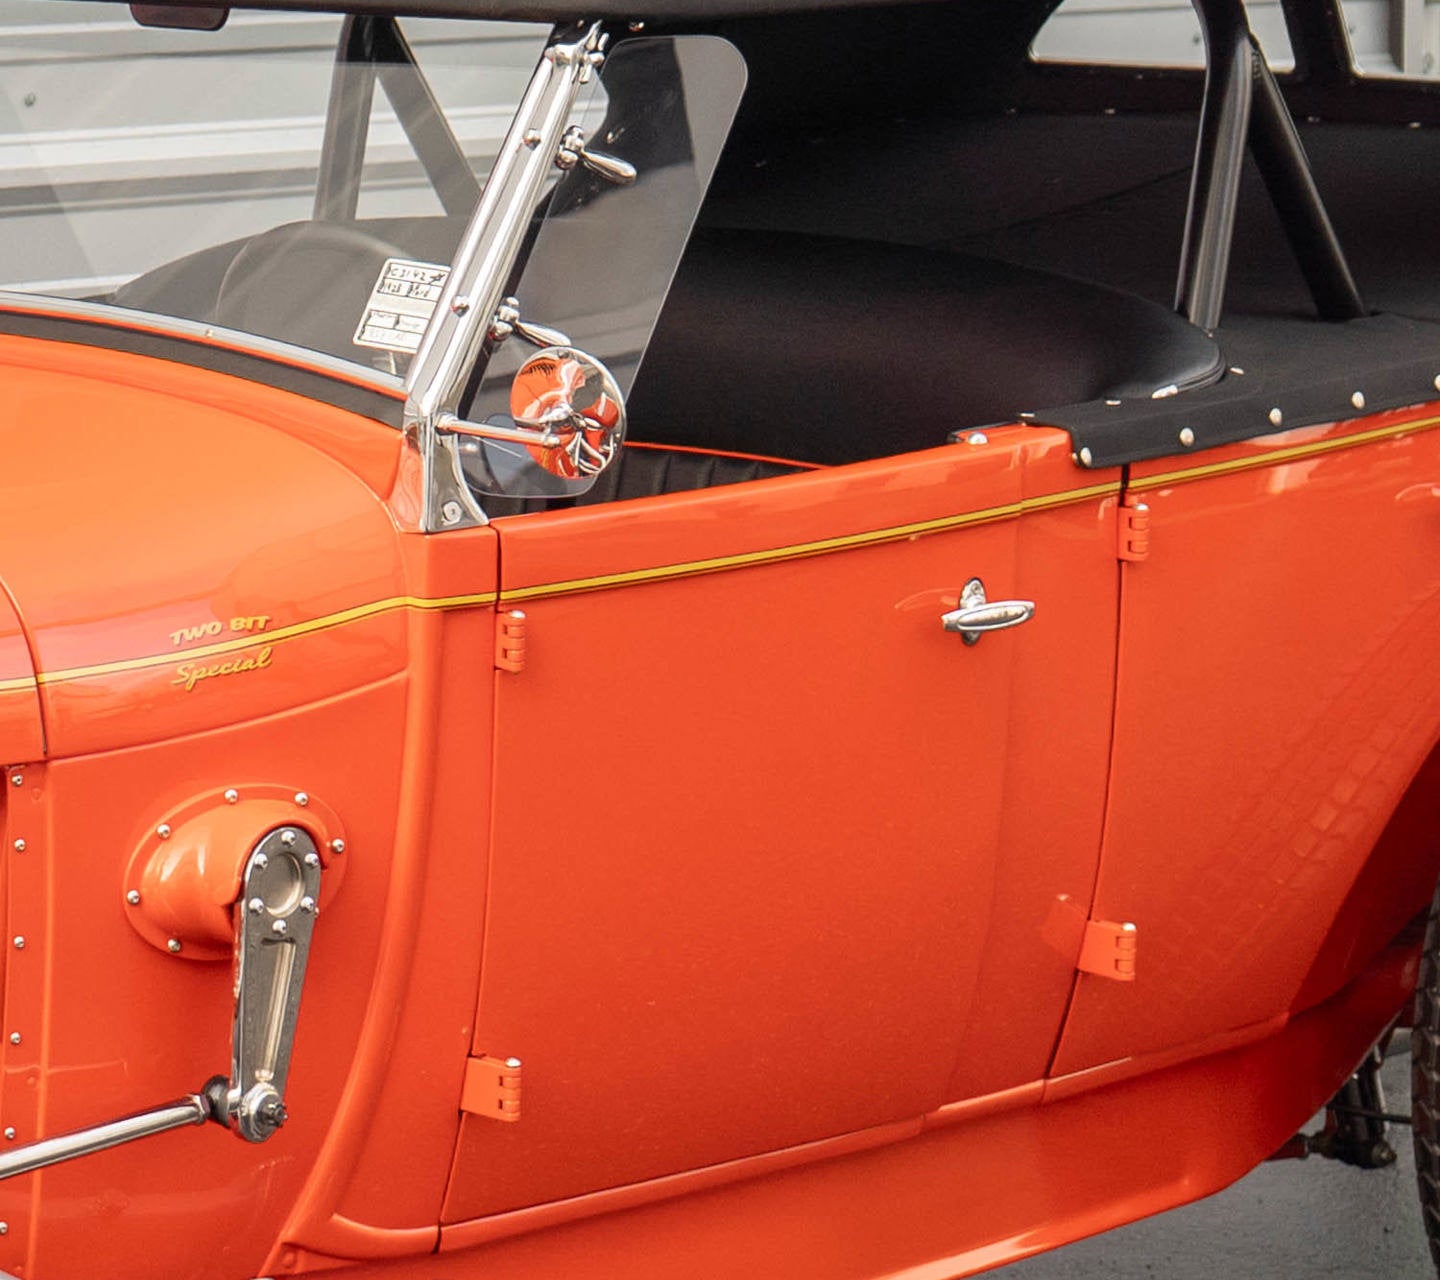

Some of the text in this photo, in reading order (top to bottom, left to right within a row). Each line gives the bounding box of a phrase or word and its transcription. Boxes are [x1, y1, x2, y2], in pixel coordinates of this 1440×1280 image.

[169, 615, 271, 646] TWO BIT
[170, 646, 273, 692] Special
